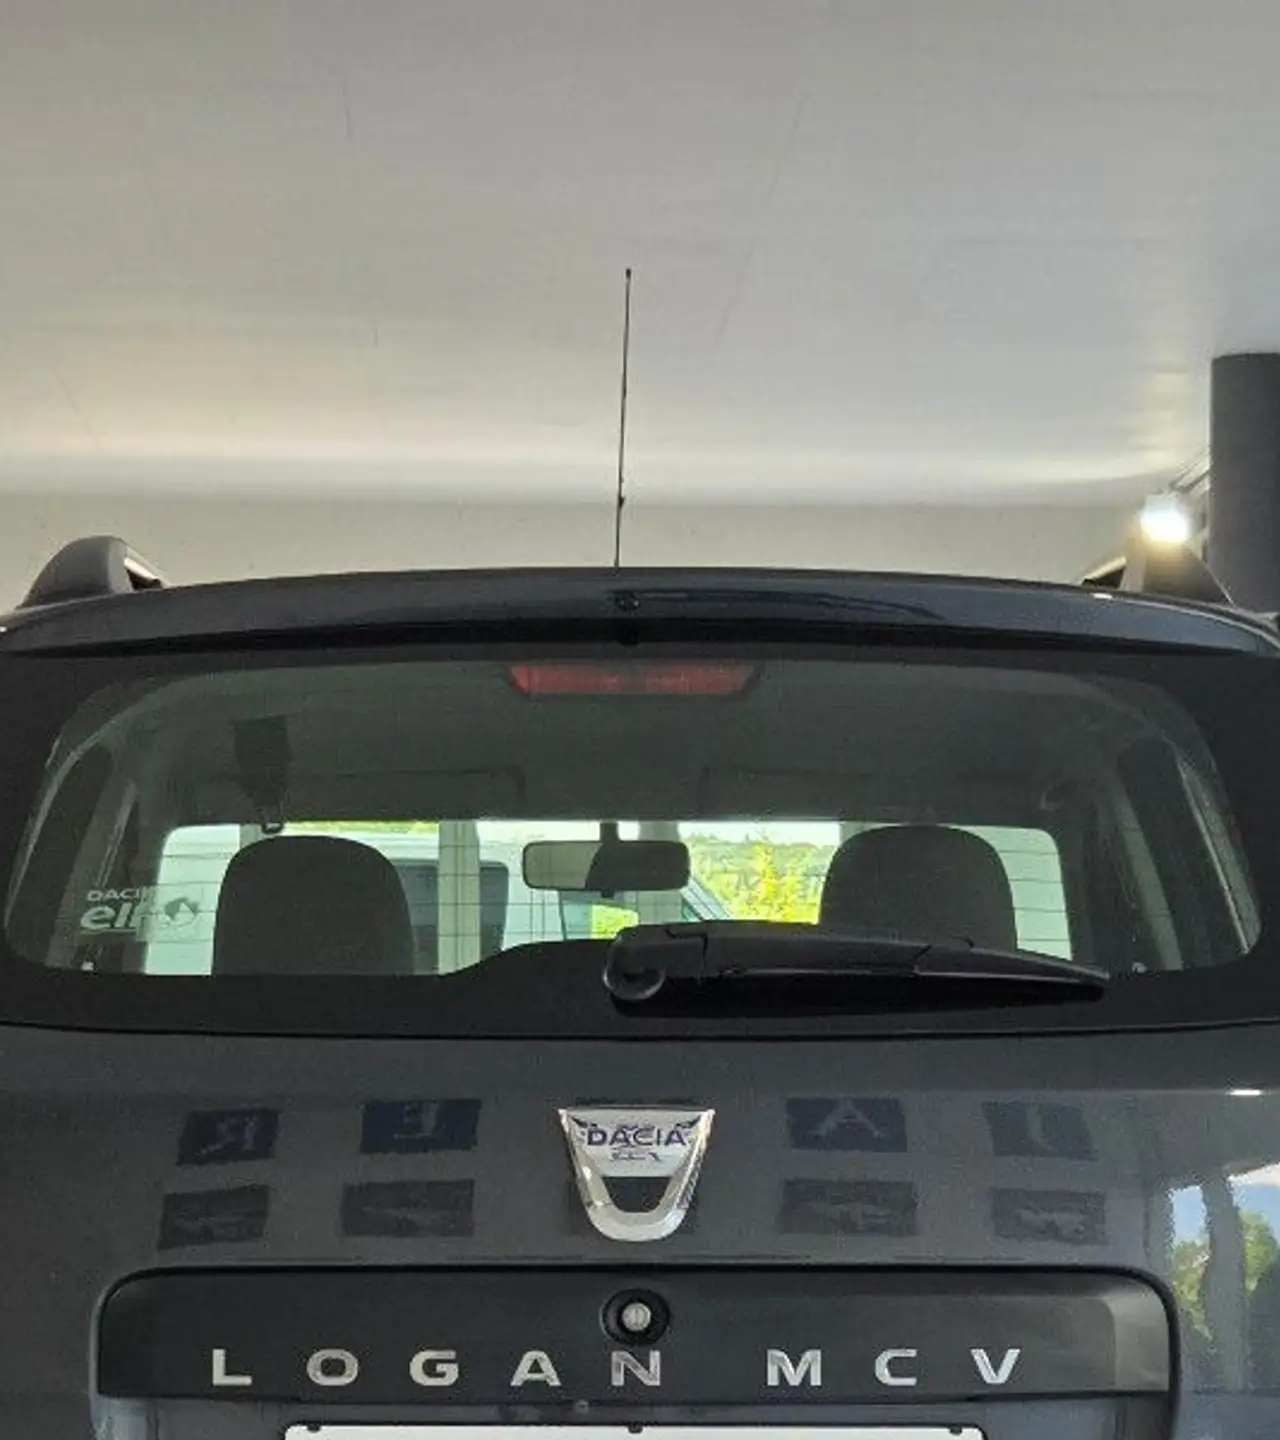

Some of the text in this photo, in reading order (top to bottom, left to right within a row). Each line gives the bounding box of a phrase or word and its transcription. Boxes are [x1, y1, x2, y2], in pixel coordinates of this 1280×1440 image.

[586, 1126, 687, 1147] DACIA
[211, 1348, 1021, 1387] LOGAN MCV
